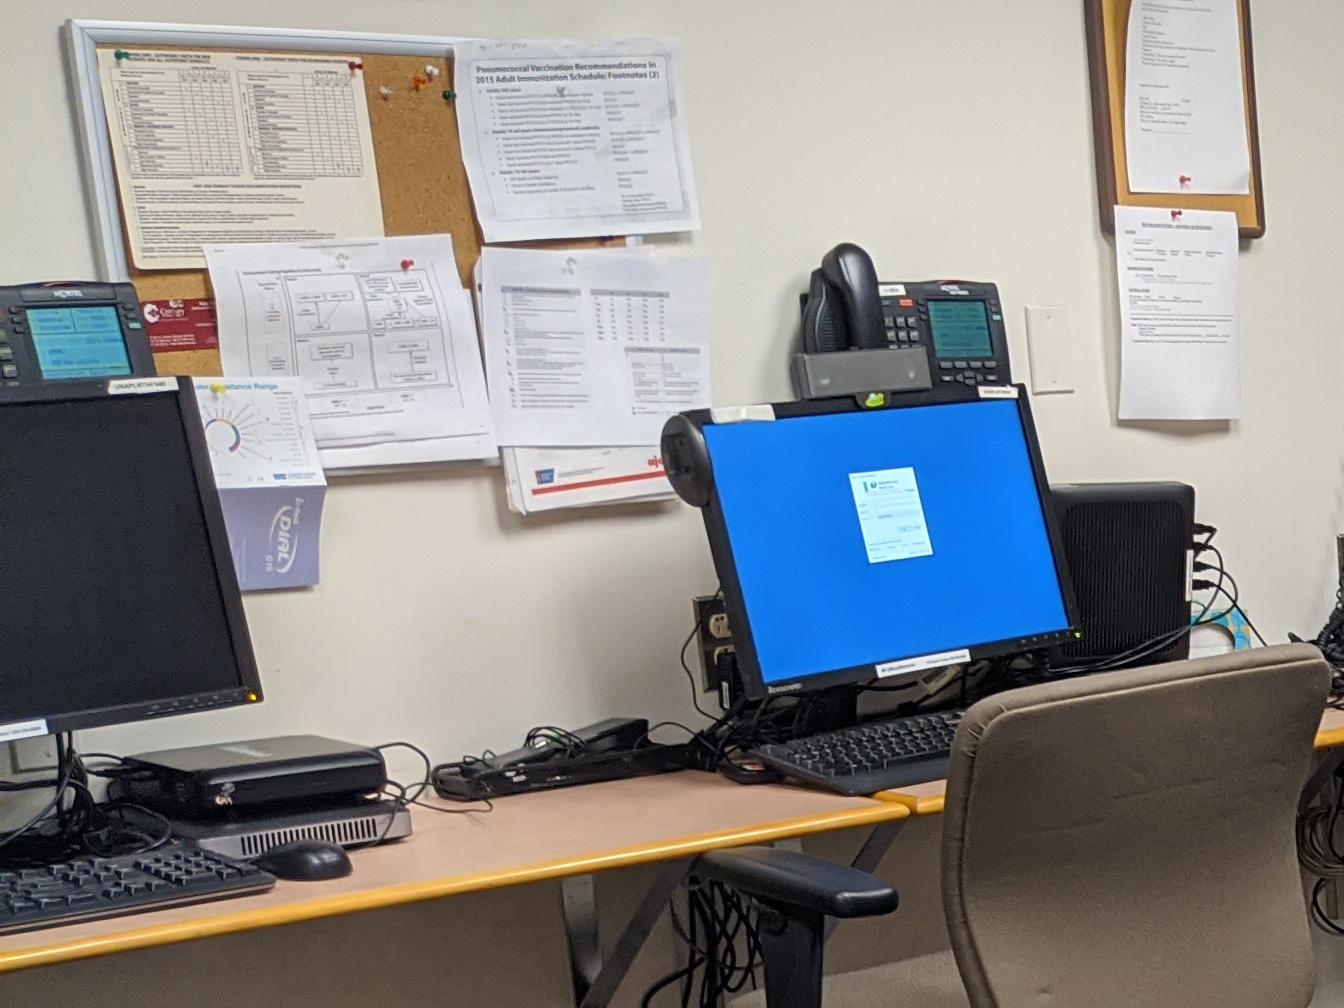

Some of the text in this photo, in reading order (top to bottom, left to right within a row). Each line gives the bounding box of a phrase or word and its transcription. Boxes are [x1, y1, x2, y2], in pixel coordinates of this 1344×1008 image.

[476, 65, 529, 73] Pneumococcal
[531, 63, 573, 72] Vaccination
[575, 62, 647, 71] Recommendations
[476, 76, 494, 84] 2015
[496, 75, 516, 83] Adult
[517, 74, 568, 82] Immunization
[608, 71, 647, 80] Footnotes
[254, 383, 278, 391] Range
[277, 516, 293, 562] DIAL
